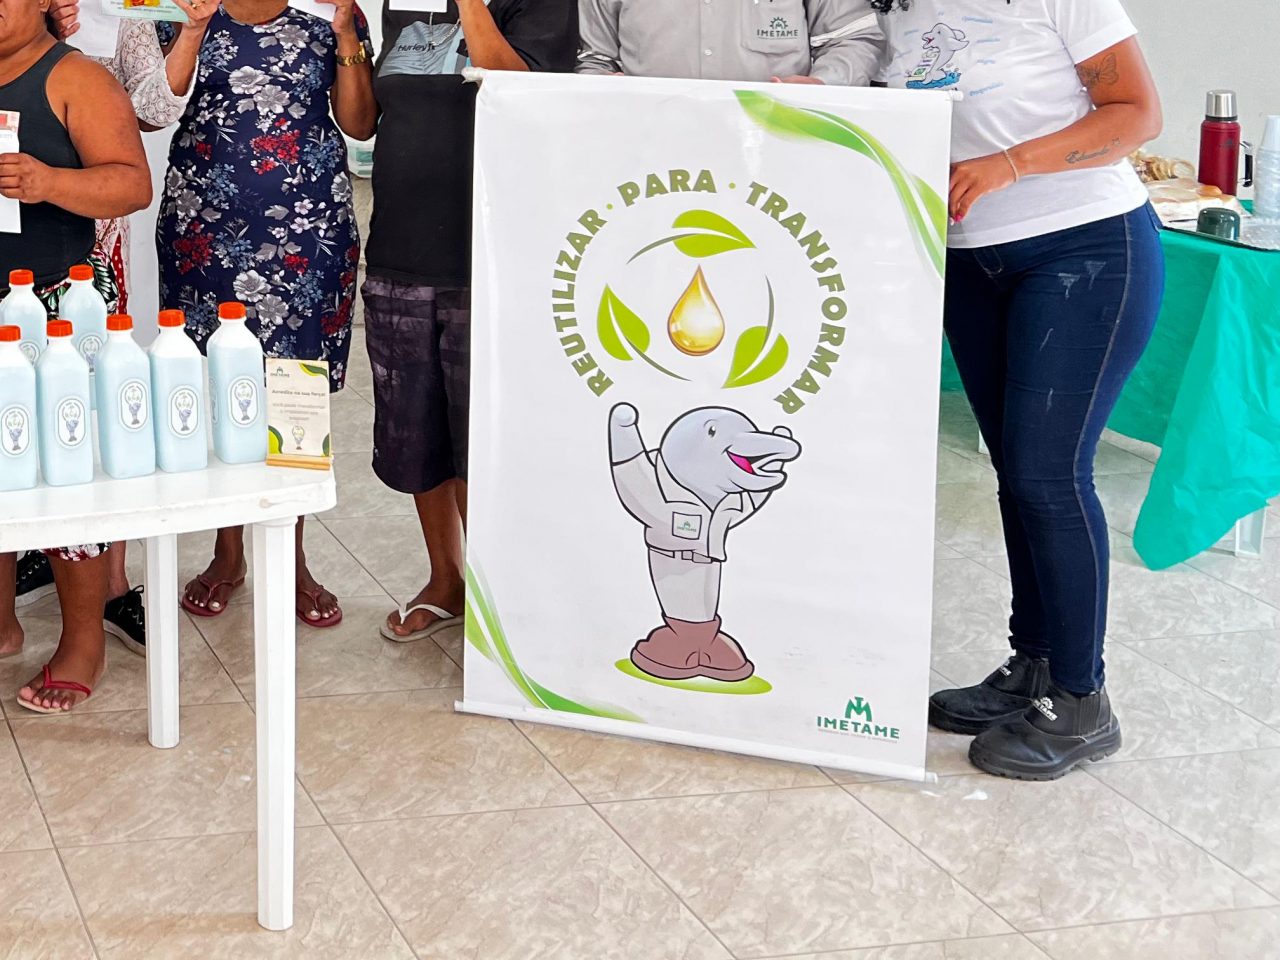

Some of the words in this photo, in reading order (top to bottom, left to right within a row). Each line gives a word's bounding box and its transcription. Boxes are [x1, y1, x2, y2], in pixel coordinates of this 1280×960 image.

[757, 29, 799, 38] IMETAME
[552, 209, 614, 397] REUTILIZAR
[617, 169, 717, 207] PARA
[745, 181, 848, 415] TRANSFORMAR
[817, 716, 900, 739] IMETAME
